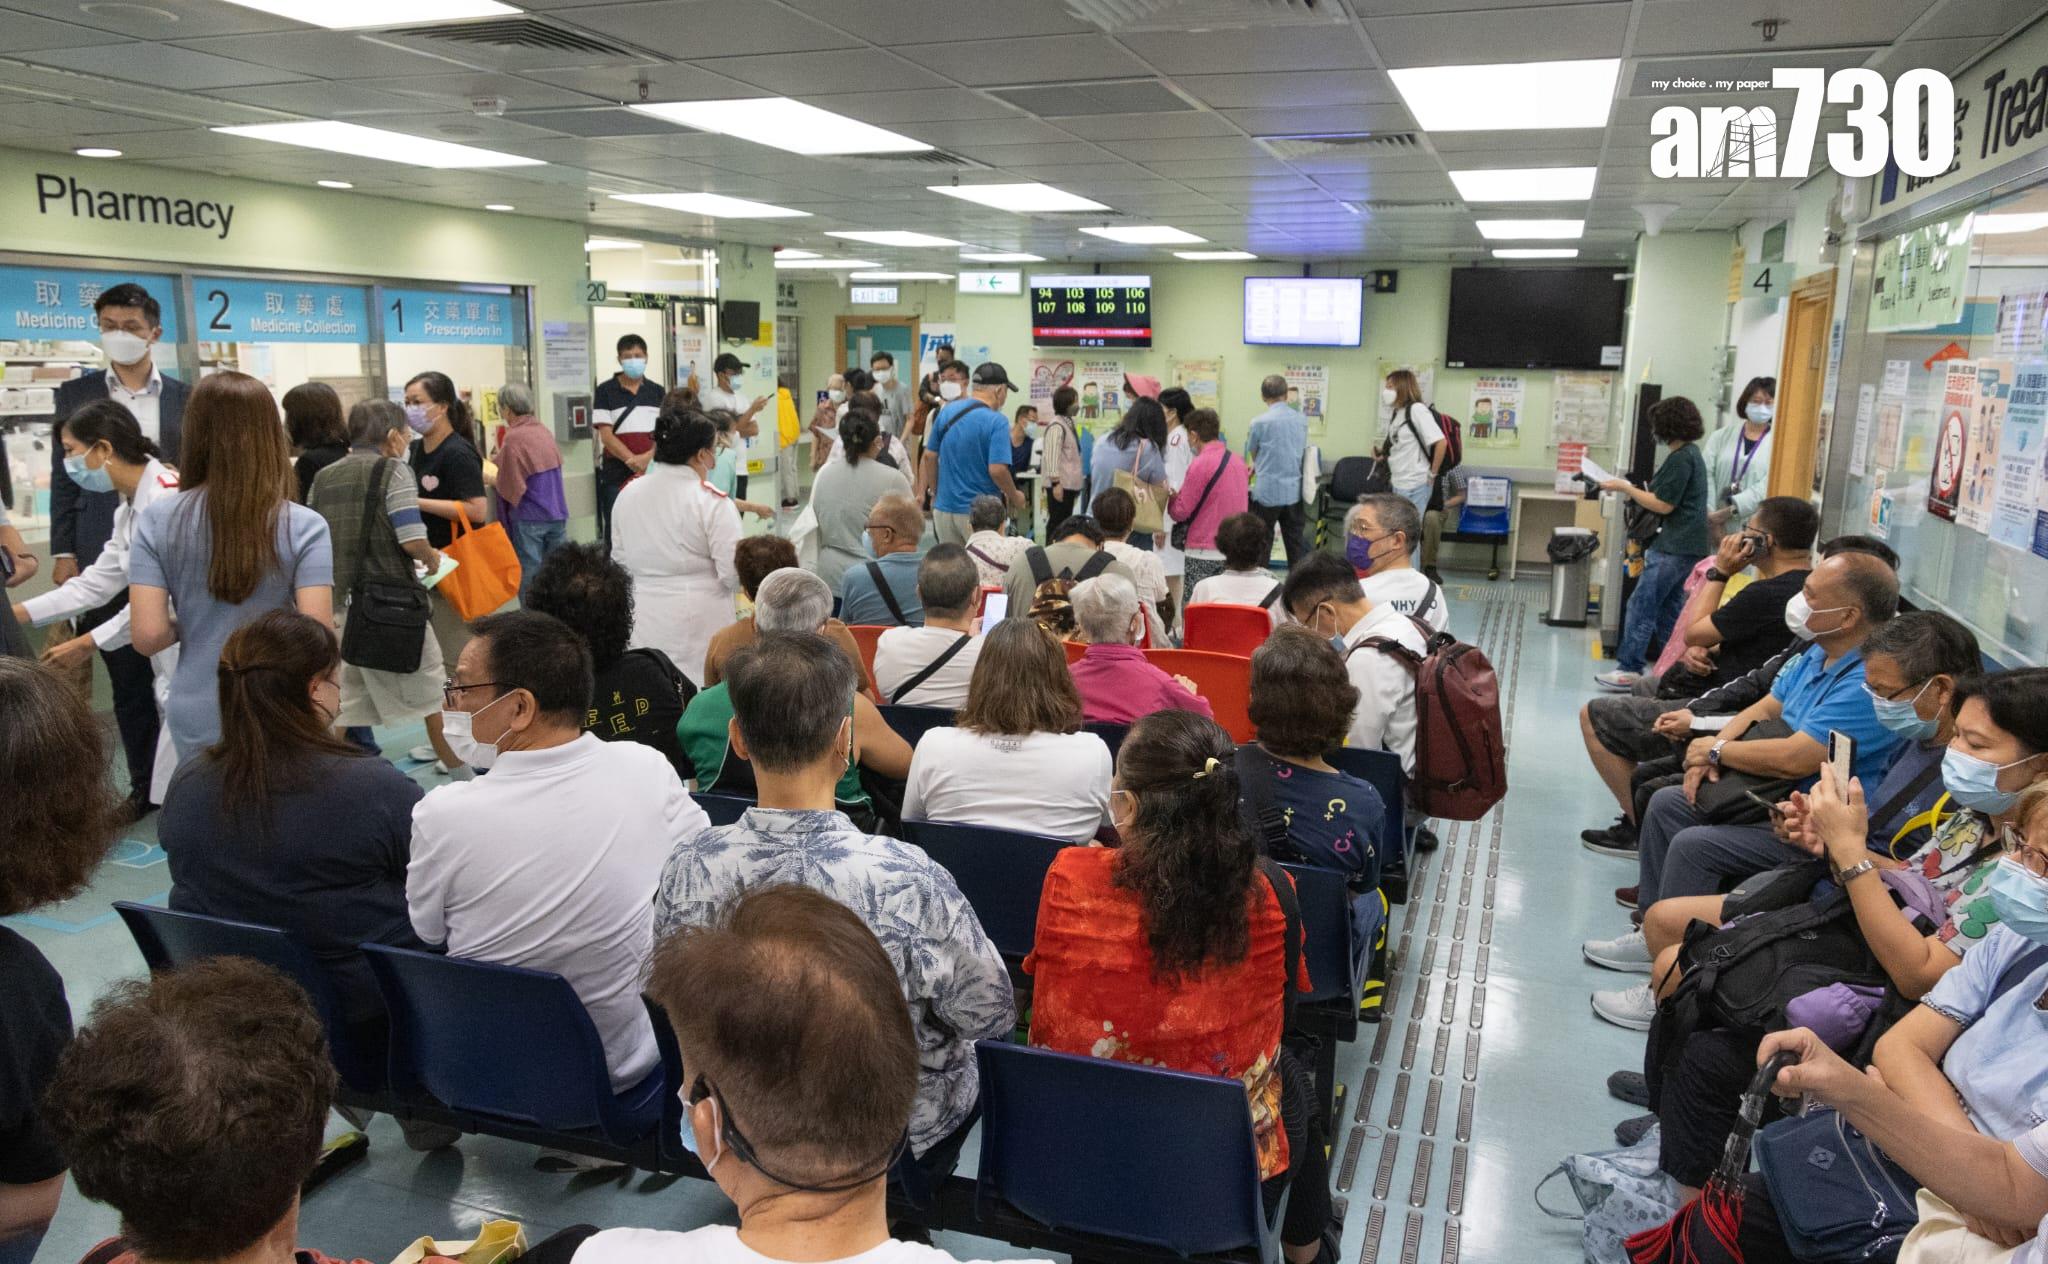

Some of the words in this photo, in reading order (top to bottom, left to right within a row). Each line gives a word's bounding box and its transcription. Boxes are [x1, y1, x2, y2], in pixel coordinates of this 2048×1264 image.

[1980, 65, 2048, 159] Trea
[36, 173, 234, 239] Pharmacy
[1753, 268, 1772, 293] 4
[587, 283, 606, 302] 20
[1039, 288, 1052, 299] 94
[1066, 288, 1085, 299] 103
[1096, 288, 1114, 299] 105
[1126, 288, 1145, 299] 106
[207, 289, 233, 330] 2
[265, 291, 344, 316] 取藥處
[424, 301, 501, 322] 交藥單處
[1037, 302, 1056, 313] 107
[1066, 302, 1086, 314] 108
[1096, 302, 1115, 314] 109
[1126, 302, 1145, 314] 110
[15, 310, 86, 329] Medicine
[391, 298, 404, 332] 1
[251, 318, 301, 333] Medicine
[304, 320, 357, 334] Collection
[424, 322, 490, 337] Prescription
